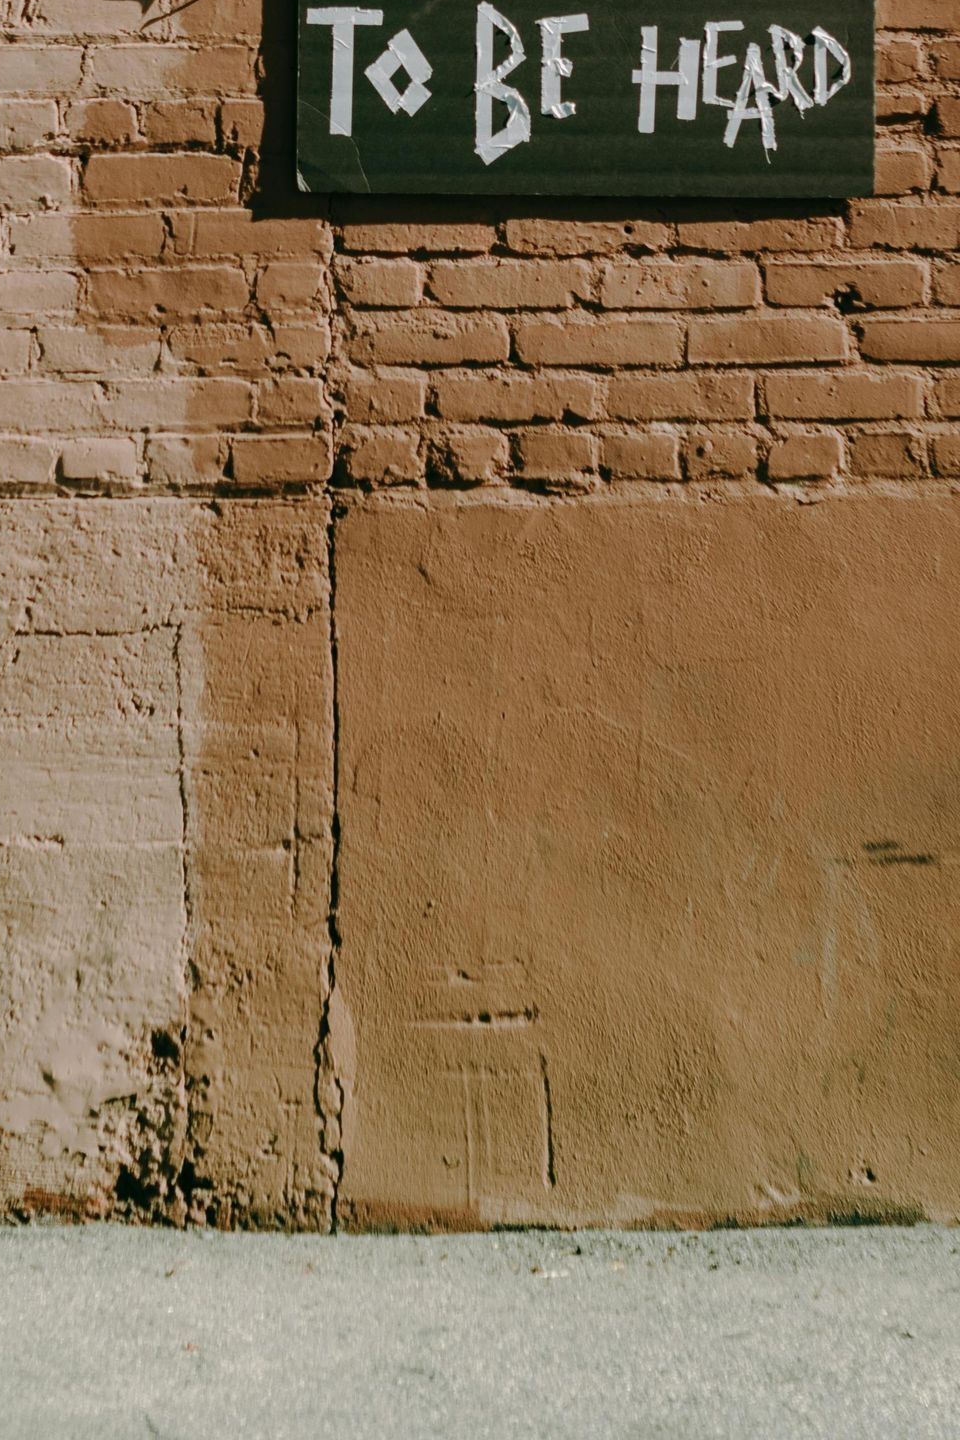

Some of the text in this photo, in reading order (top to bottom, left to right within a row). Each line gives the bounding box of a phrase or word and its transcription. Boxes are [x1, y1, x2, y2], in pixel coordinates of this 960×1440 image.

[305, 0, 852, 166] TO BE HEARD
